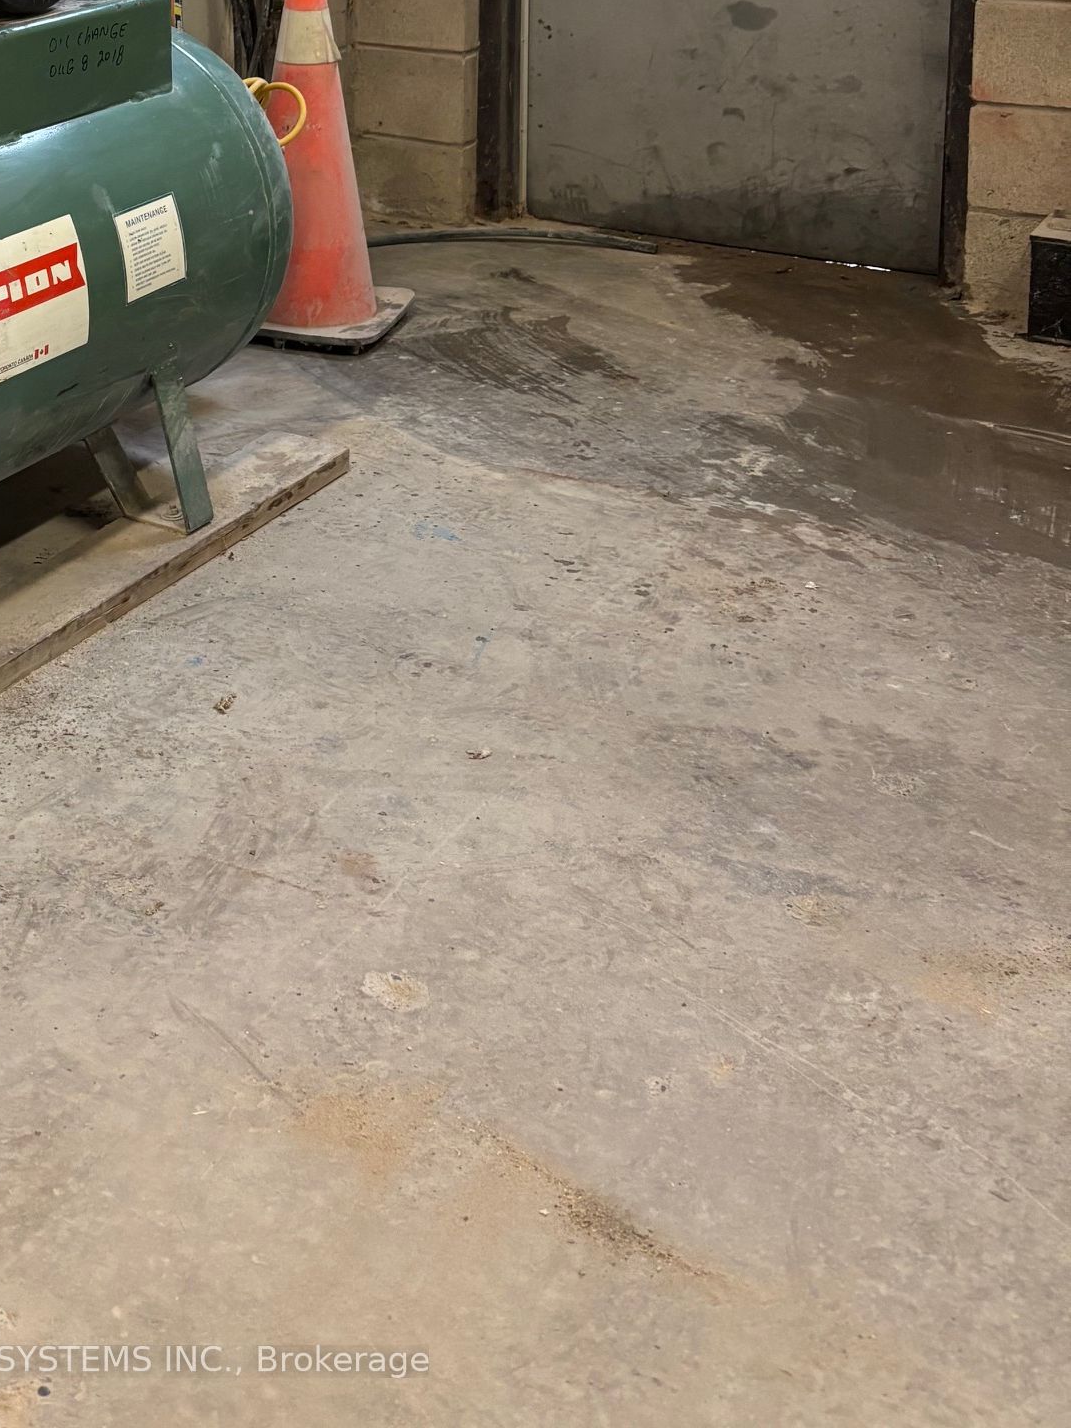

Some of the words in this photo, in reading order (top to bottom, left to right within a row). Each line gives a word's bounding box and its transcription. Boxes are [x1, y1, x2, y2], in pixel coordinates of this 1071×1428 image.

[81, 54, 89, 71] 8
[97, 45, 124, 67] 2018
[125, 205, 168, 228] MAINTENANCE
